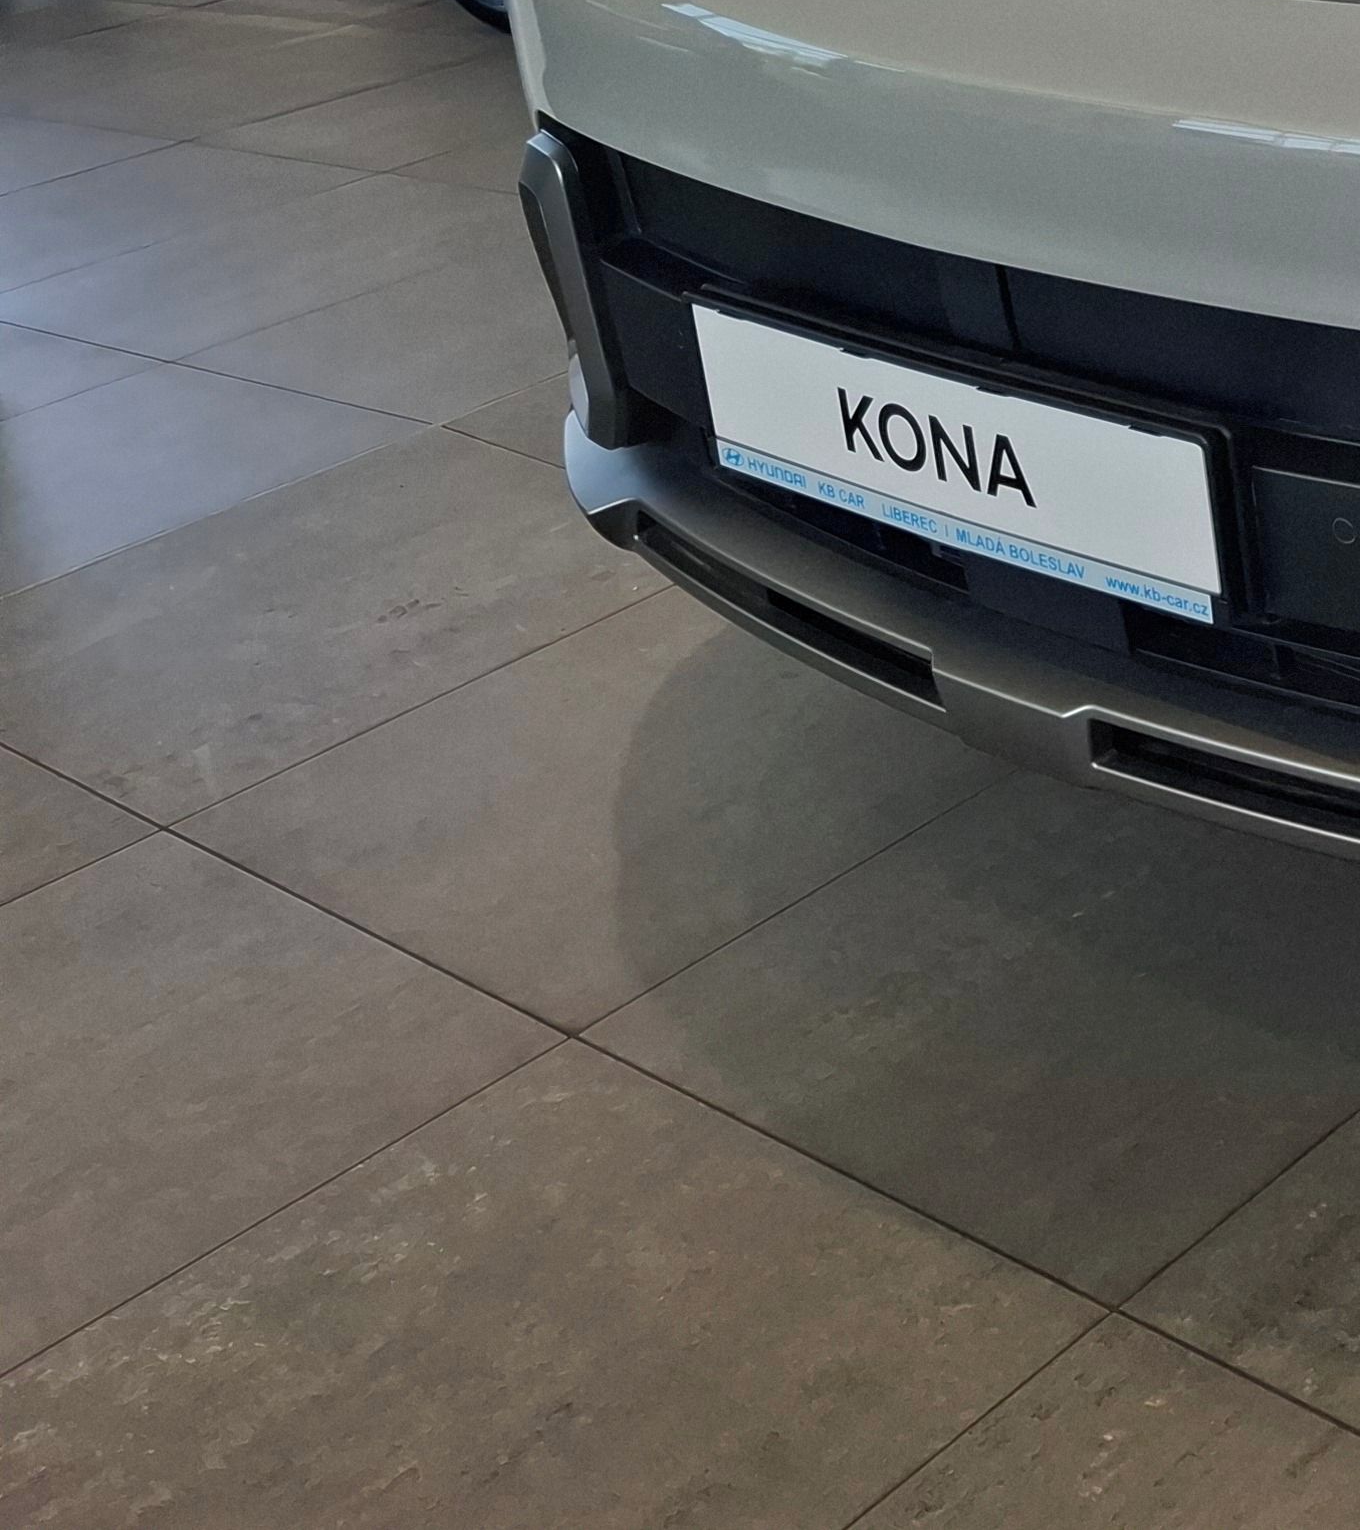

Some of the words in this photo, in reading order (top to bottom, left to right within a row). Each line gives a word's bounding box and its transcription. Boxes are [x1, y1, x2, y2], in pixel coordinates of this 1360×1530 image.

[836, 386, 1038, 509] KONA
[747, 456, 808, 489] HYUNDAI
[818, 480, 836, 499] KB
[838, 488, 865, 509] CAR
[881, 503, 938, 534] LIBEREC
[1009, 543, 1086, 579] BOLESLAV
[1105, 576, 1209, 617] www.kb-car.cz
